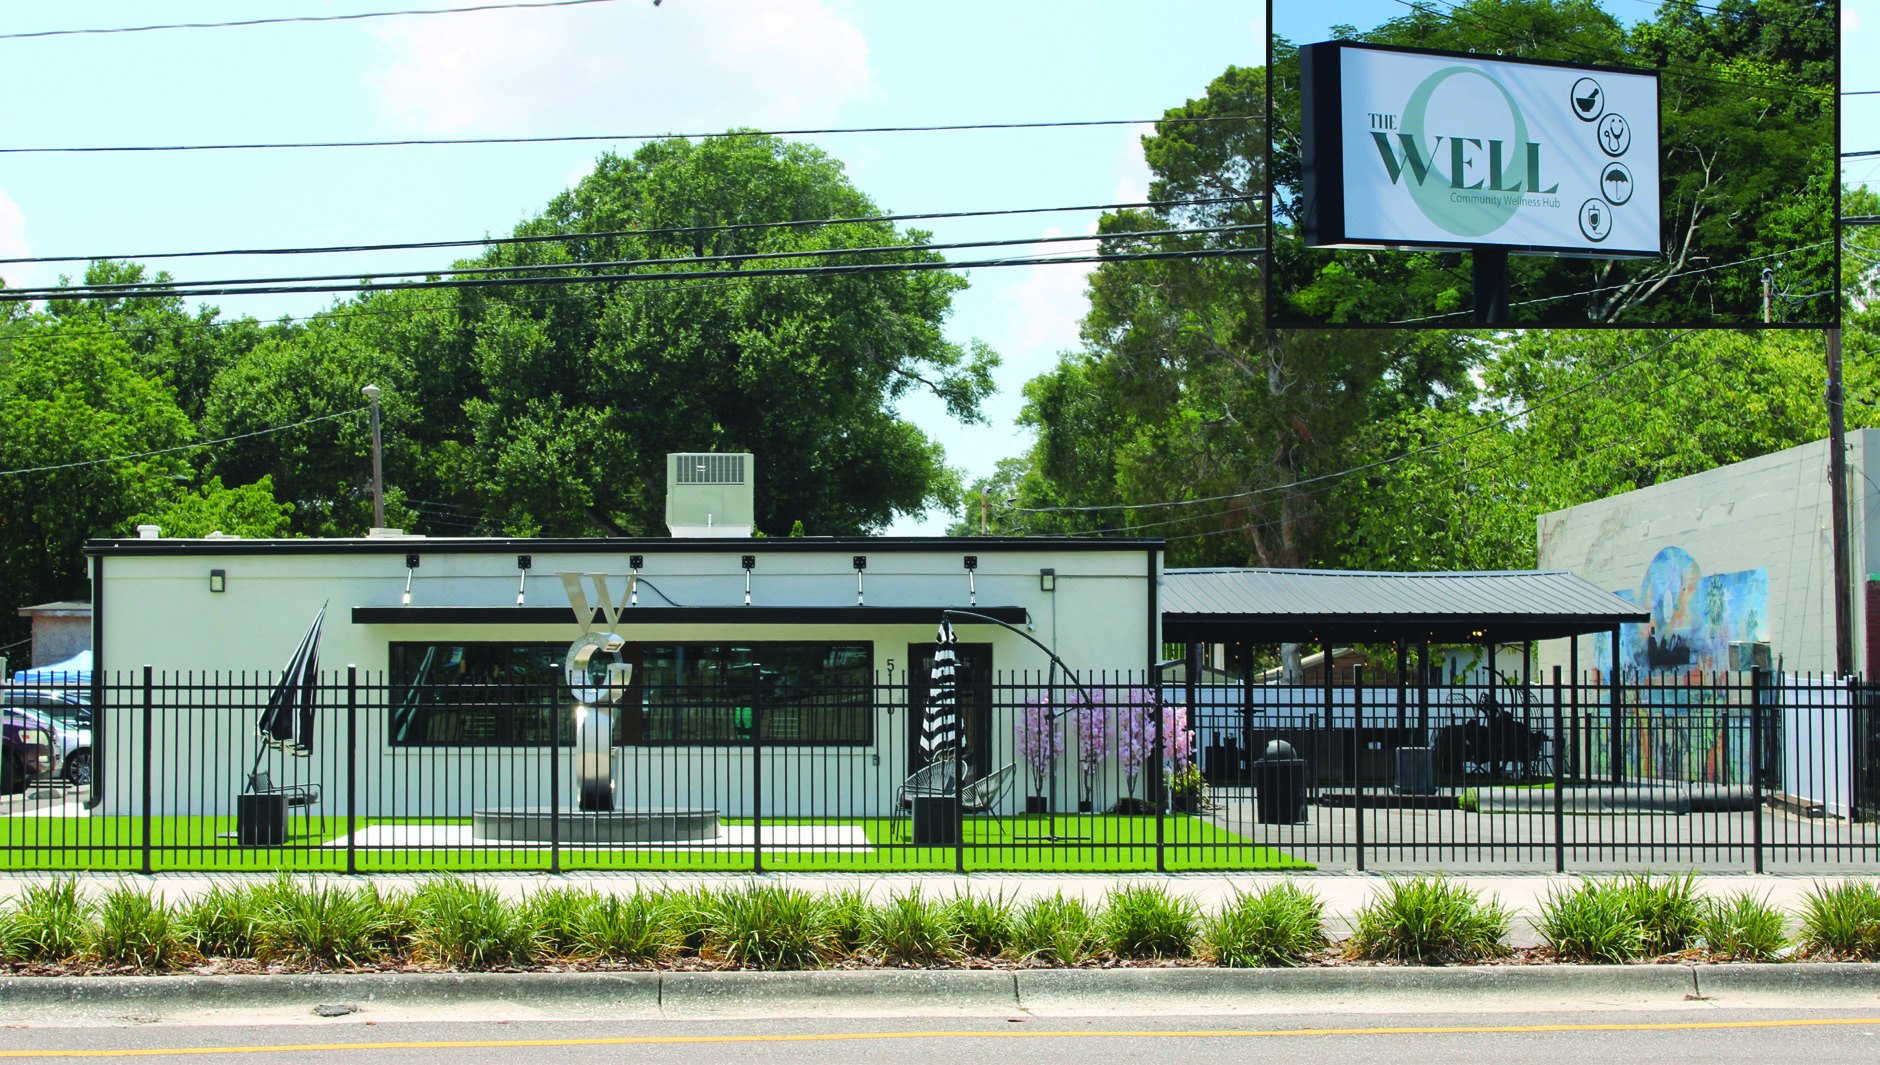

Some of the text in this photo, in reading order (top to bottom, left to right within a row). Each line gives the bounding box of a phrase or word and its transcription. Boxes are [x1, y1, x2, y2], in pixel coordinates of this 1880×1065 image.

[1367, 112, 1398, 130] THE
[1370, 131, 1560, 194] WELL
[1450, 192, 1561, 208] Community Wellness Hub
